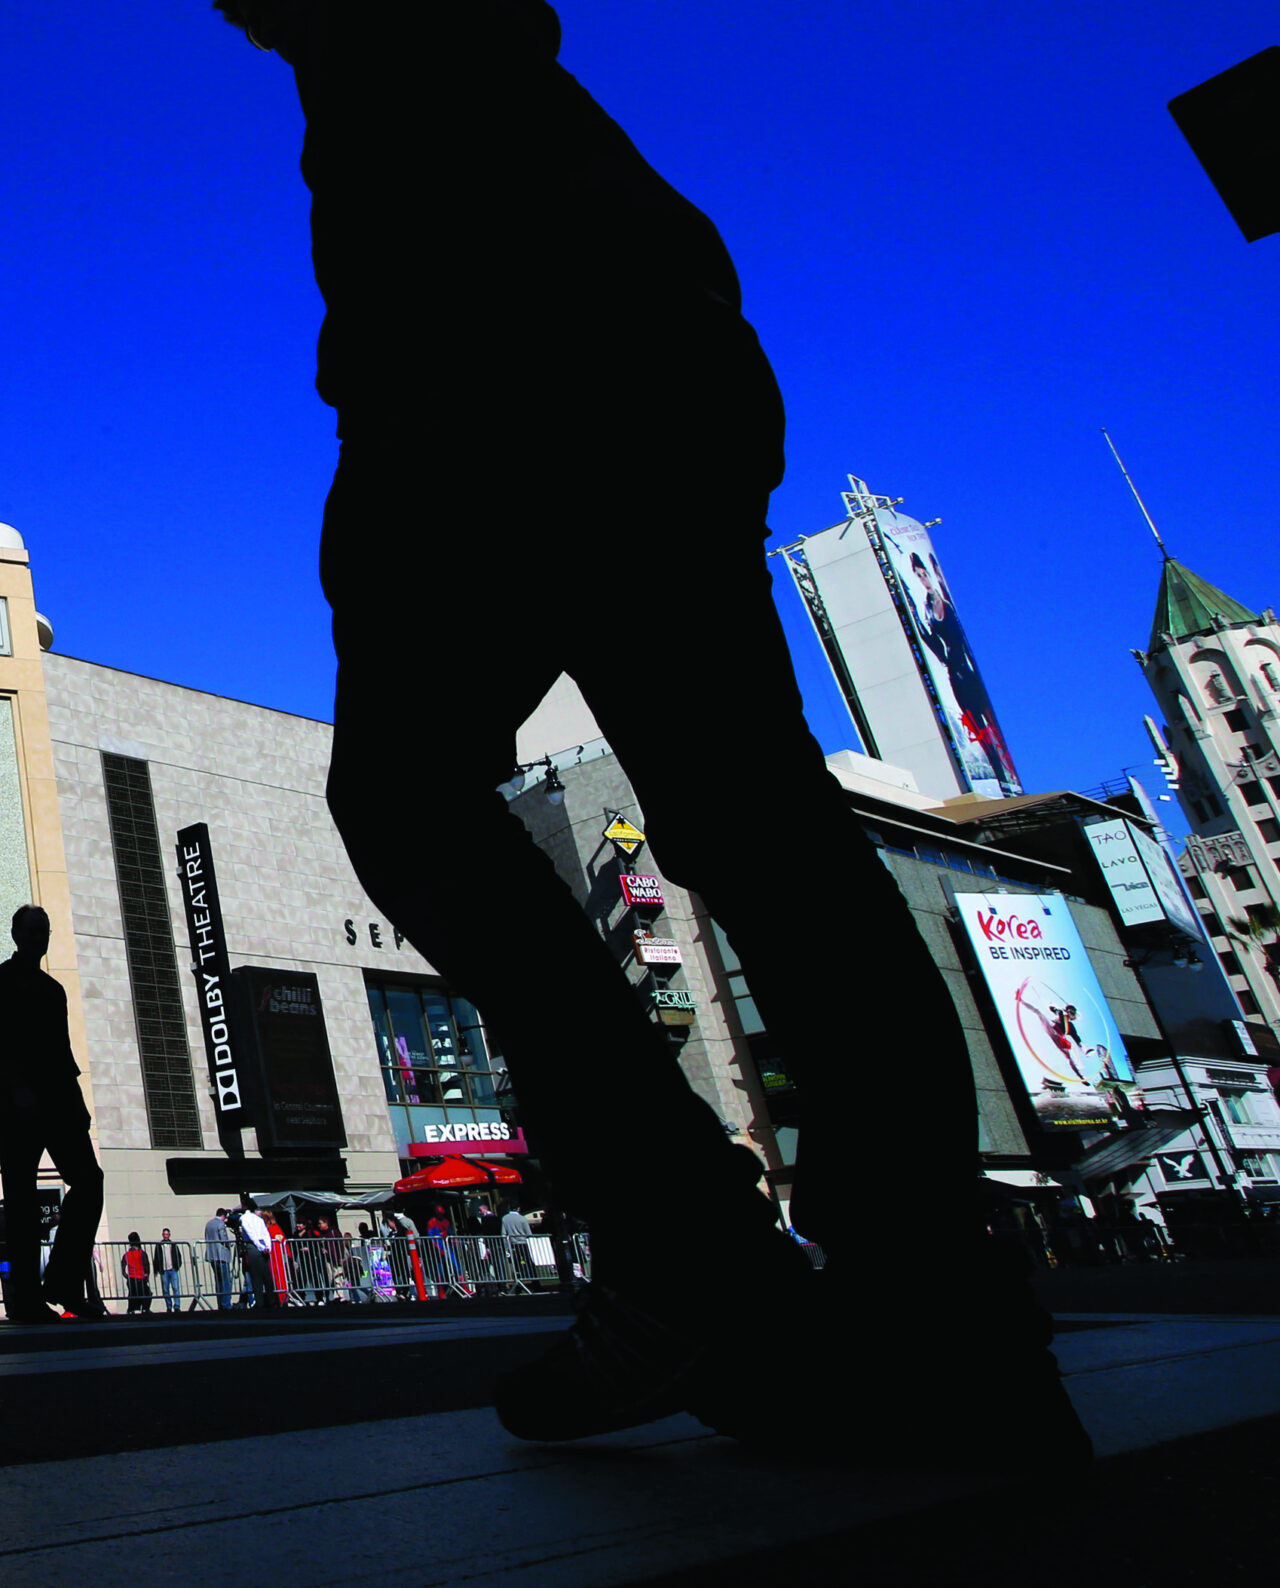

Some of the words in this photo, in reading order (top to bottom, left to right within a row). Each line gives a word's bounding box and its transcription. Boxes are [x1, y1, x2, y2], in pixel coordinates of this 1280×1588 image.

[1091, 831, 1127, 846] TAO
[1101, 855, 1138, 869] LAVO
[626, 876, 659, 888] CABO
[629, 887, 662, 898] WABO
[183, 841, 217, 966] THEATRE
[977, 910, 1042, 943] Korea
[989, 946, 1009, 960] BE
[1011, 946, 1071, 960] INSPIRED
[273, 985, 312, 1003] chilli
[665, 992, 696, 1005] GRILL
[270, 999, 318, 1016] beans
[202, 973, 233, 1066] DOLBY
[424, 1122, 510, 1143] EXPRESS
